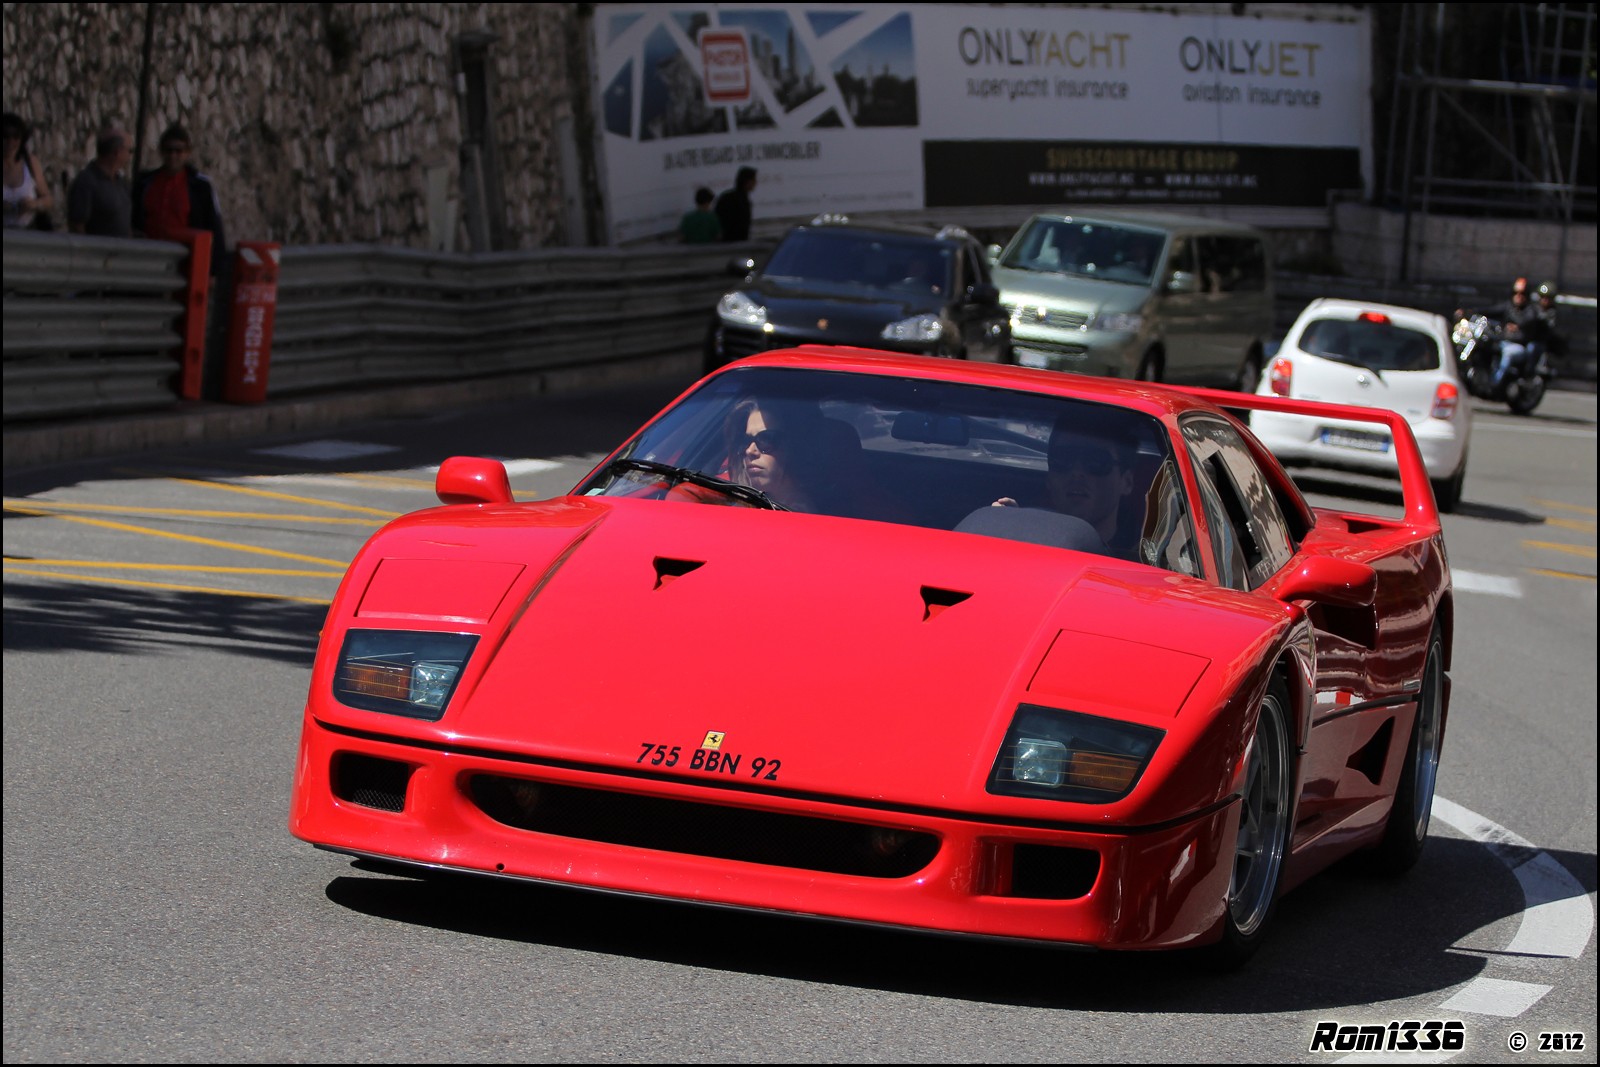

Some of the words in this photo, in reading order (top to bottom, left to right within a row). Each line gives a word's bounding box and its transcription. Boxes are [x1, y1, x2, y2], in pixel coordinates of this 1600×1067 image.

[967, 78, 1049, 101] superyacht
[1054, 79, 1128, 100] insurance
[1182, 83, 1241, 105] aviation
[1247, 86, 1321, 107] insurance
[1183, 151, 1239, 170] GROUP
[636, 743, 681, 767] 755
[689, 749, 742, 775] BBN
[750, 757, 781, 780] 92
